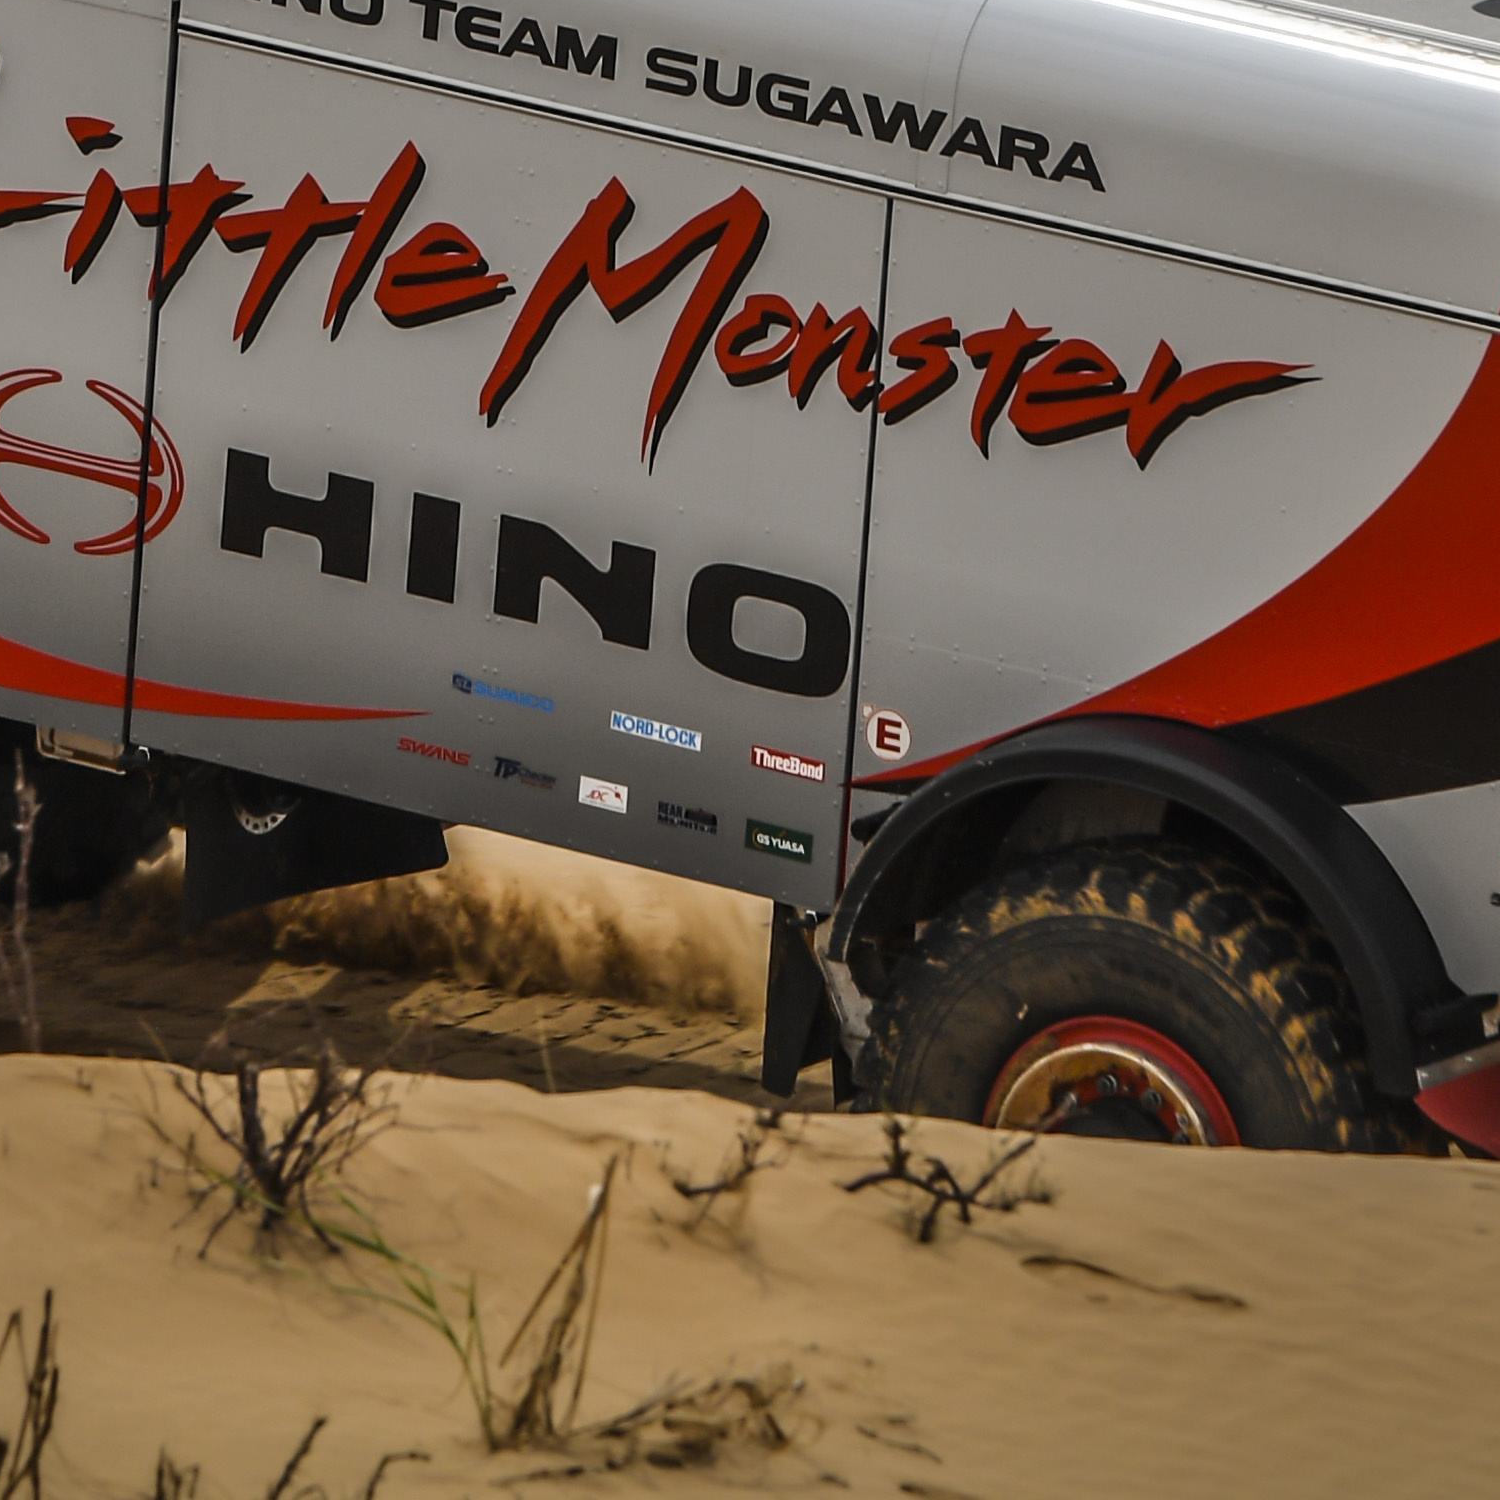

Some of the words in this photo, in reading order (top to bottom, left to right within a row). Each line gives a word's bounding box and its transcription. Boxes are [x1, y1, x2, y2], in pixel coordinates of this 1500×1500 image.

[643, 46, 1106, 193] SUGAWARA
[478, 175, 1323, 476] Monster
[220, 447, 852, 698] HINO
[612, 712, 698, 749] NORD-LOCK
[876, 716, 902, 753] E
[397, 736, 472, 767] SWANS
[753, 747, 823, 782] ThreeBond
[771, 834, 805, 855] YUASA
